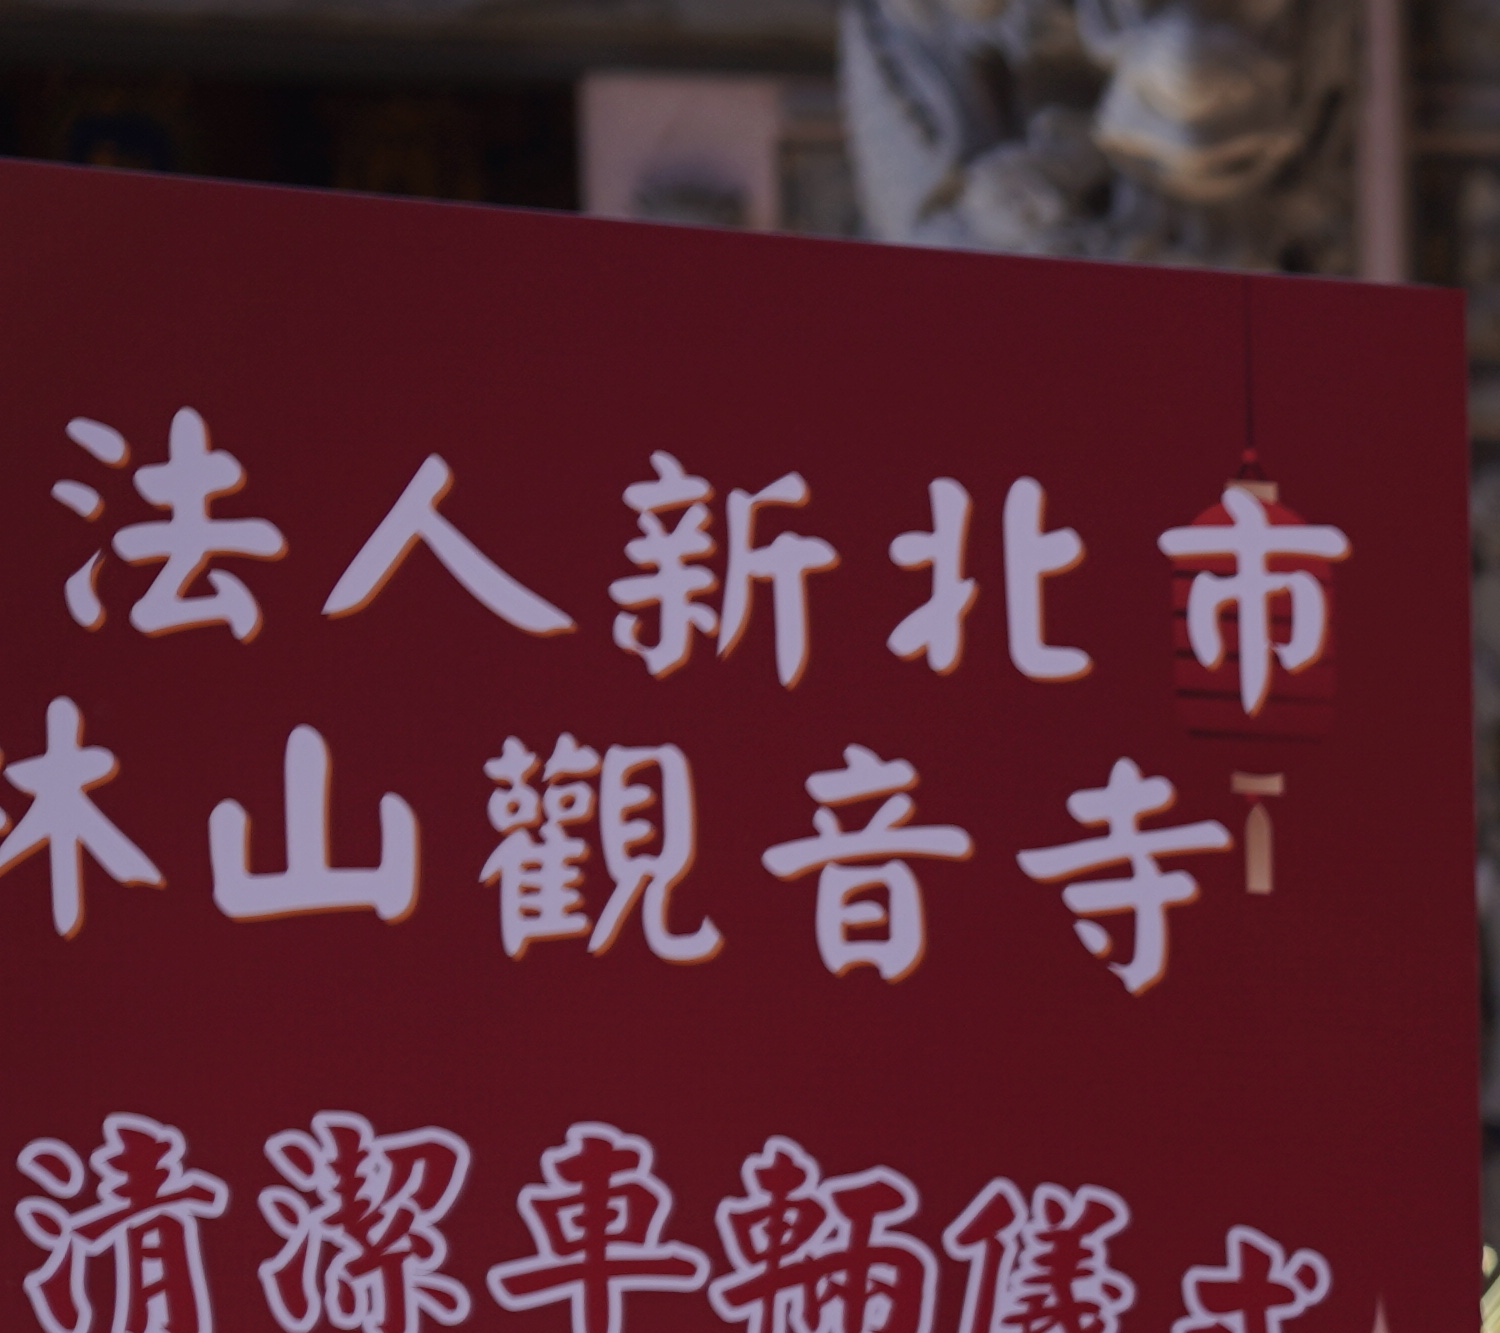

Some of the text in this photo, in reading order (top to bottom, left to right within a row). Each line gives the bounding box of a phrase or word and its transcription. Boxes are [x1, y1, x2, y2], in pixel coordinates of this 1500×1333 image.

[46, 407, 1349, 731] 法人新北市
